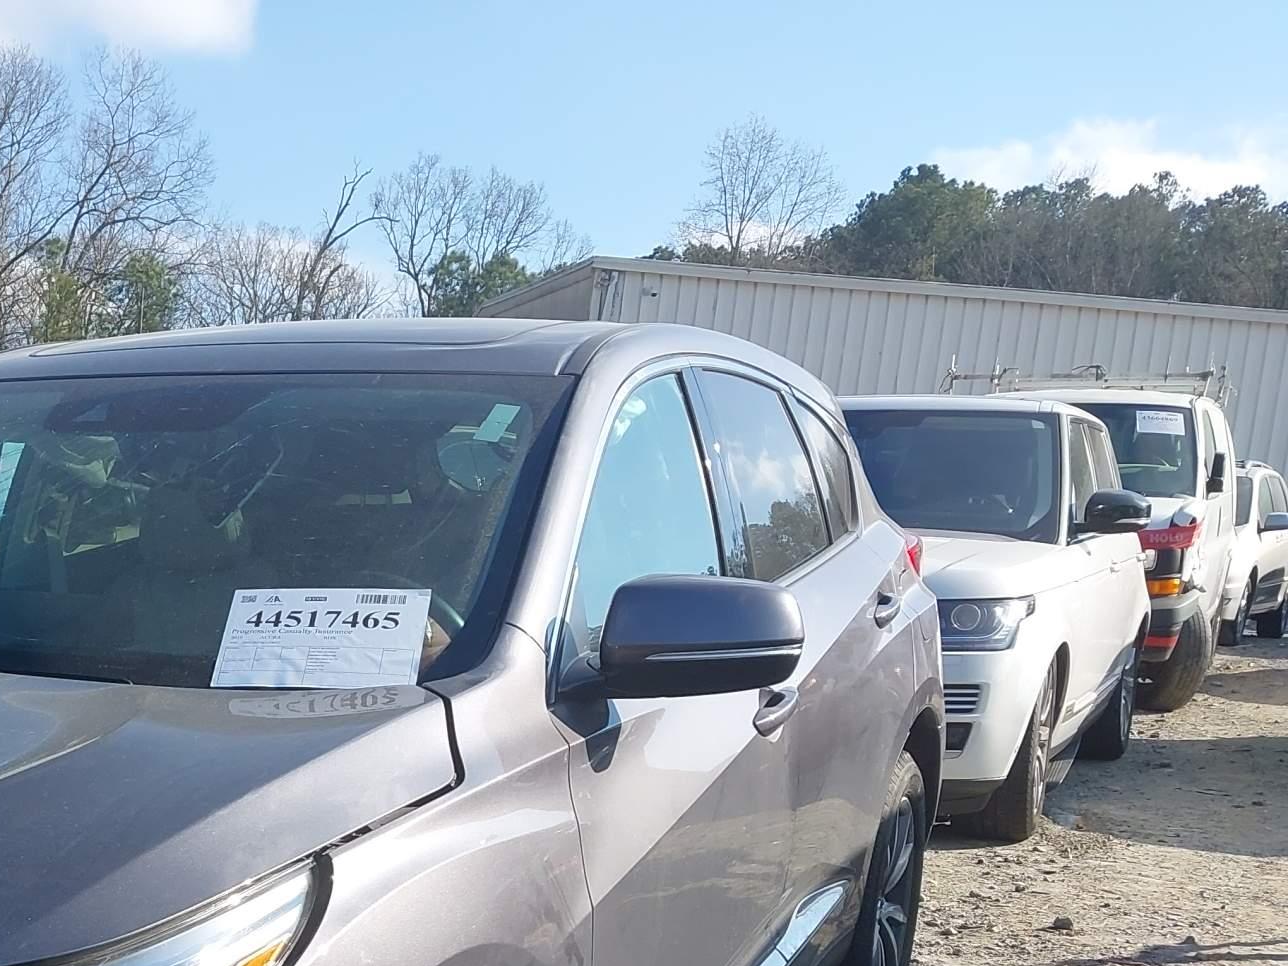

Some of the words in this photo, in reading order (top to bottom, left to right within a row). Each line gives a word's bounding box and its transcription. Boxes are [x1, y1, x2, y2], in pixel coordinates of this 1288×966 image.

[246, 609, 401, 629] 44517465
[232, 628, 277, 636] Progressive
[278, 628, 313, 636] Casualty
